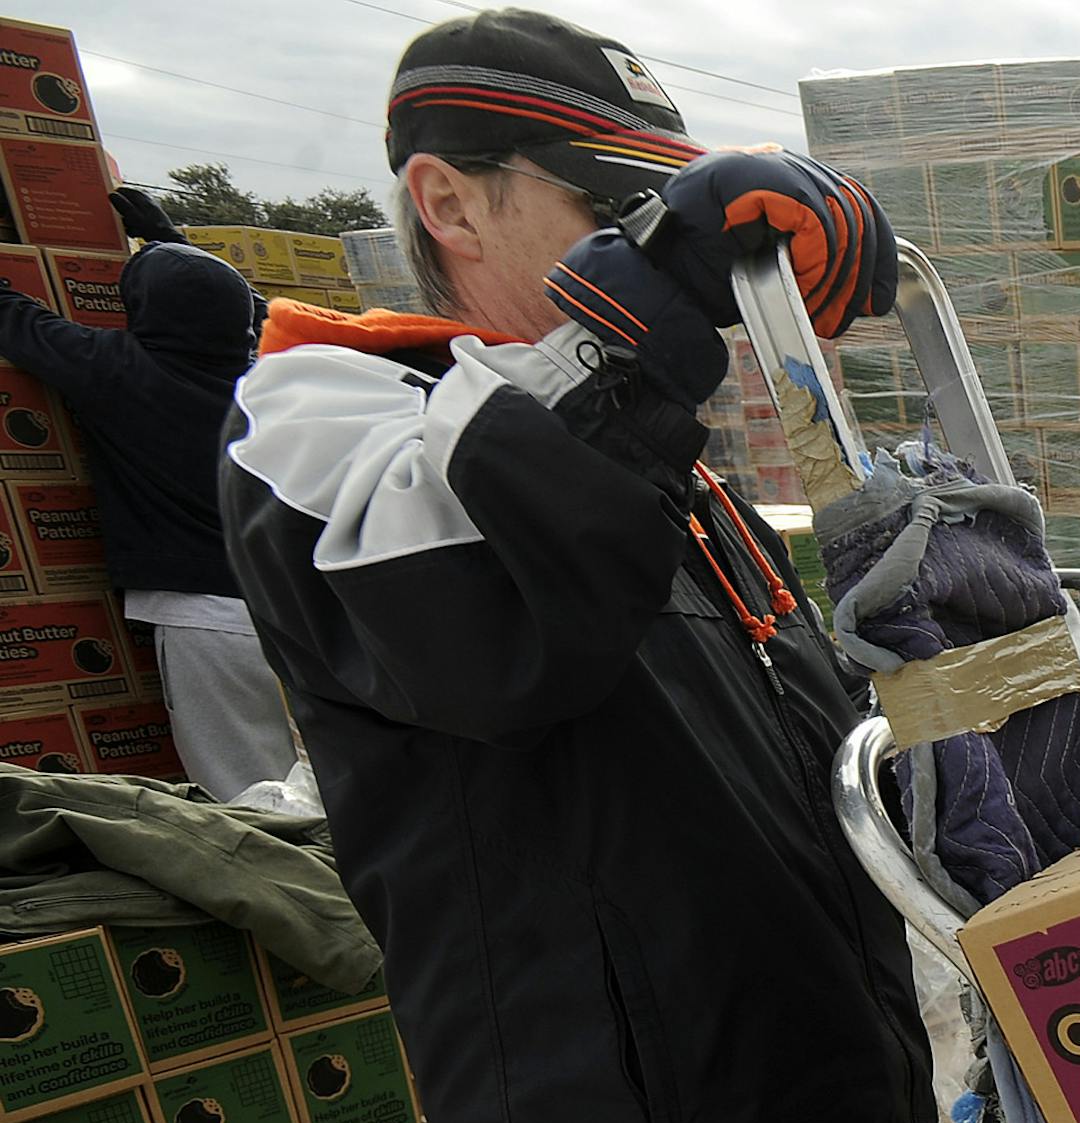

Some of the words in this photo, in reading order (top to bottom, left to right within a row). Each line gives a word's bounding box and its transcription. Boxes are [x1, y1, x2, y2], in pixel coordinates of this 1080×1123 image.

[28, 509, 88, 524] Peanut
[23, 626, 77, 641] Butter
[91, 727, 146, 745] Peanut
[60, 1031, 98, 1052] build
[79, 1041, 124, 1064] skills
[7, 1084, 37, 1102] and
